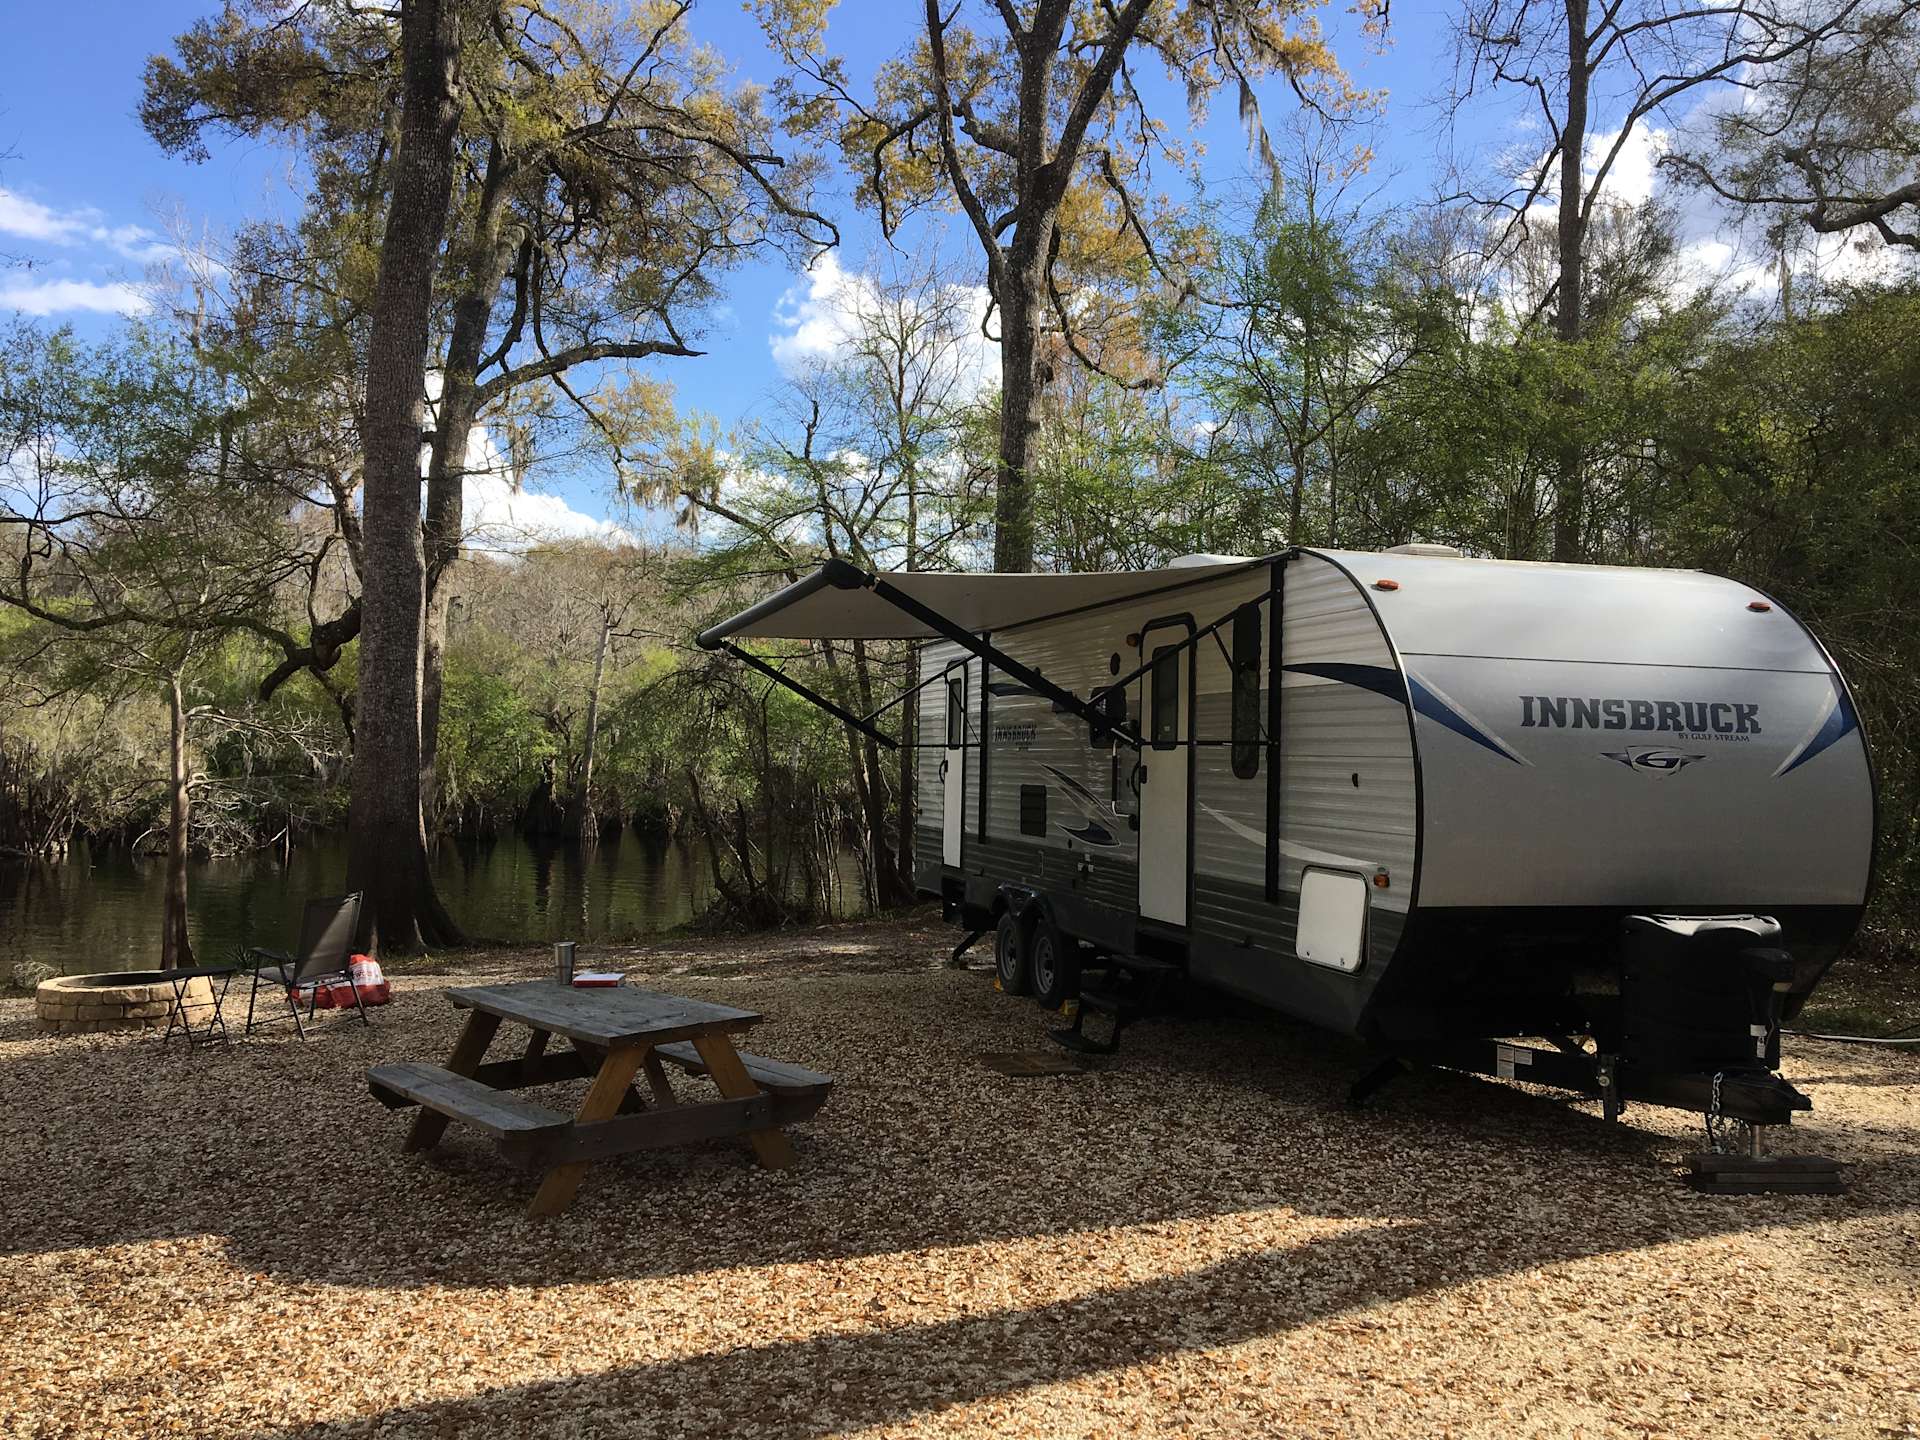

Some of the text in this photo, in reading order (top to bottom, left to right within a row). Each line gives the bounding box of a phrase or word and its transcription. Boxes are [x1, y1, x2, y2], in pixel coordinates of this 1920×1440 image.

[1518, 695, 1762, 734] INNSBRUCK
[1678, 732, 1750, 742] BY GULF STREAM
